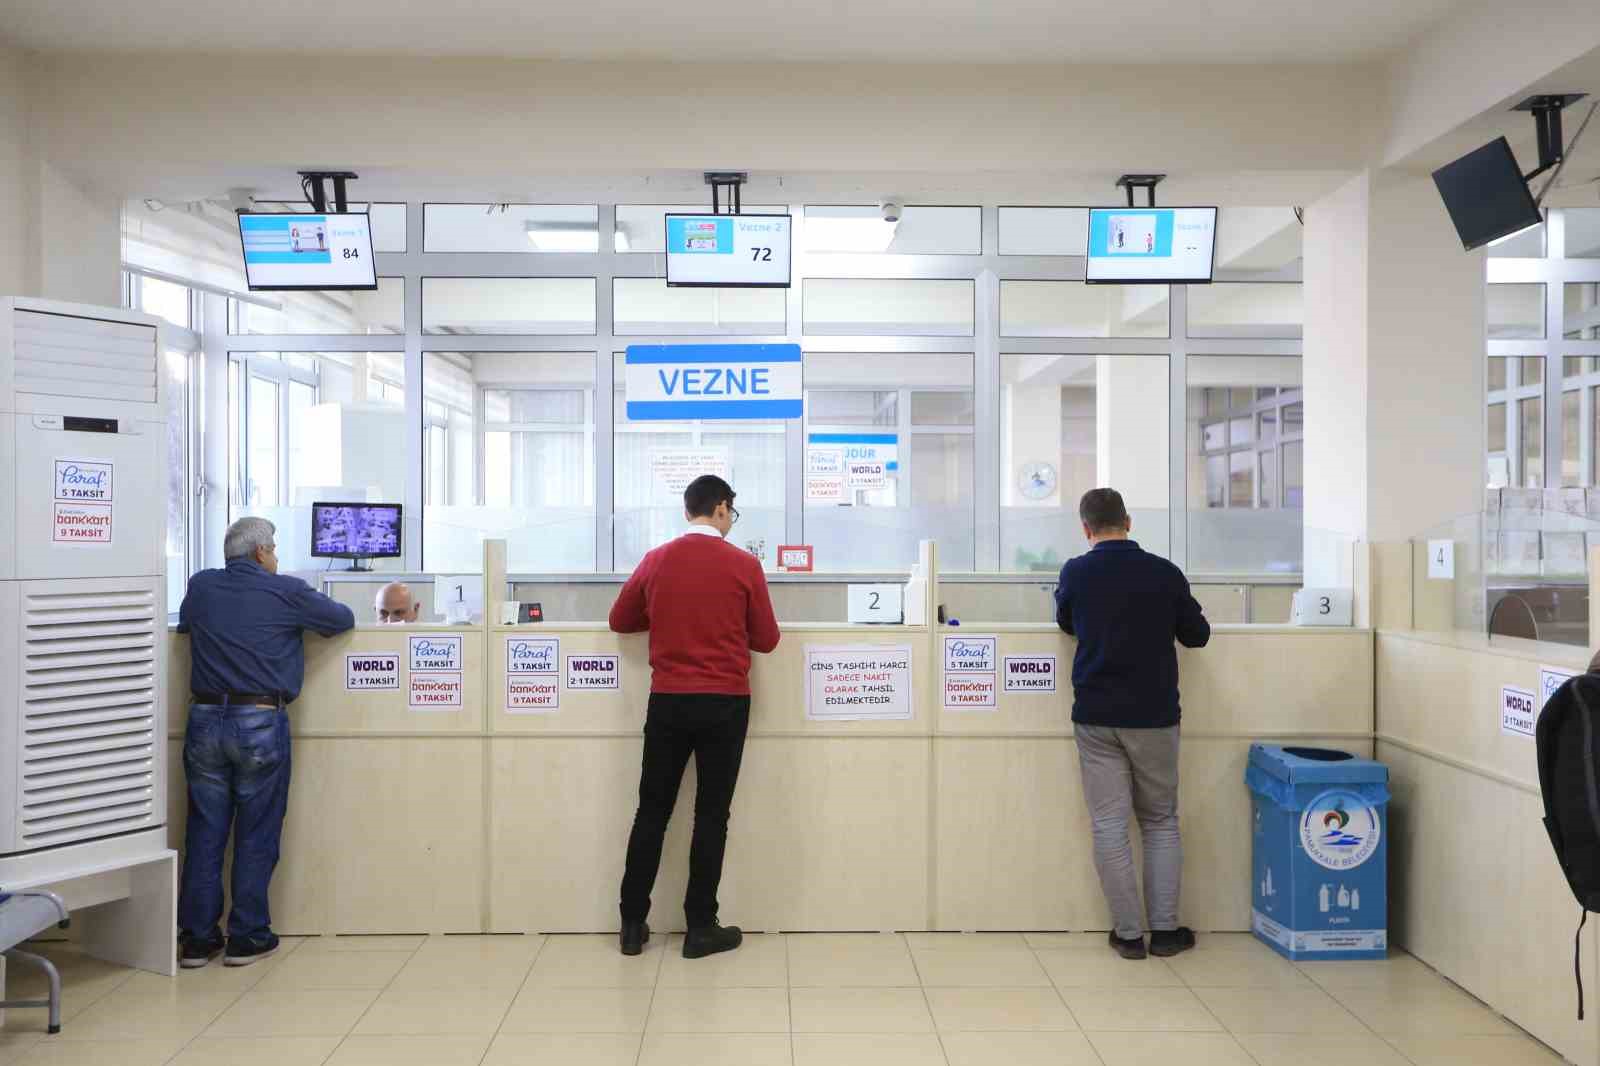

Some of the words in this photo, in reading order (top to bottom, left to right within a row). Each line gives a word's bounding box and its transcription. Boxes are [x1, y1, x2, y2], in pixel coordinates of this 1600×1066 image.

[343, 248, 359, 259] 84
[751, 247, 772, 262] 72
[659, 368, 770, 395] VEZNE
[851, 465, 881, 474] WORLD
[59, 465, 107, 488] Paraf
[71, 488, 105, 498] TAKSİT
[57, 514, 111, 525] bankkart
[61, 528, 67, 537] 9
[70, 528, 104, 537] TAKSİT
[1436, 547, 1445, 567] 4
[455, 584, 464, 603] 1
[868, 591, 881, 610] 2
[1319, 596, 1331, 615] 3
[413, 640, 456, 659] Paraf
[511, 642, 553, 661] Paraf
[948, 641, 990, 660] Paraf
[352, 660, 395, 672] WORLD
[423, 660, 454, 668] TAKSİT
[521, 662, 552, 670] TAKSİT
[572, 660, 614, 672] WORLD
[1009, 662, 1051, 673] WORLD
[364, 676, 395, 685] TAKSİT
[584, 676, 616, 685] TAKSİT
[826, 673, 860, 682] SADECE
[412, 683, 459, 691] bankkart
[510, 685, 556, 693] bankkart
[824, 685, 859, 694] OLARAK
[947, 683, 992, 692] bankkart
[423, 694, 454, 702] TAKSİT
[520, 696, 551, 704] TAKSİT
[1506, 695, 1532, 713] WORLD
